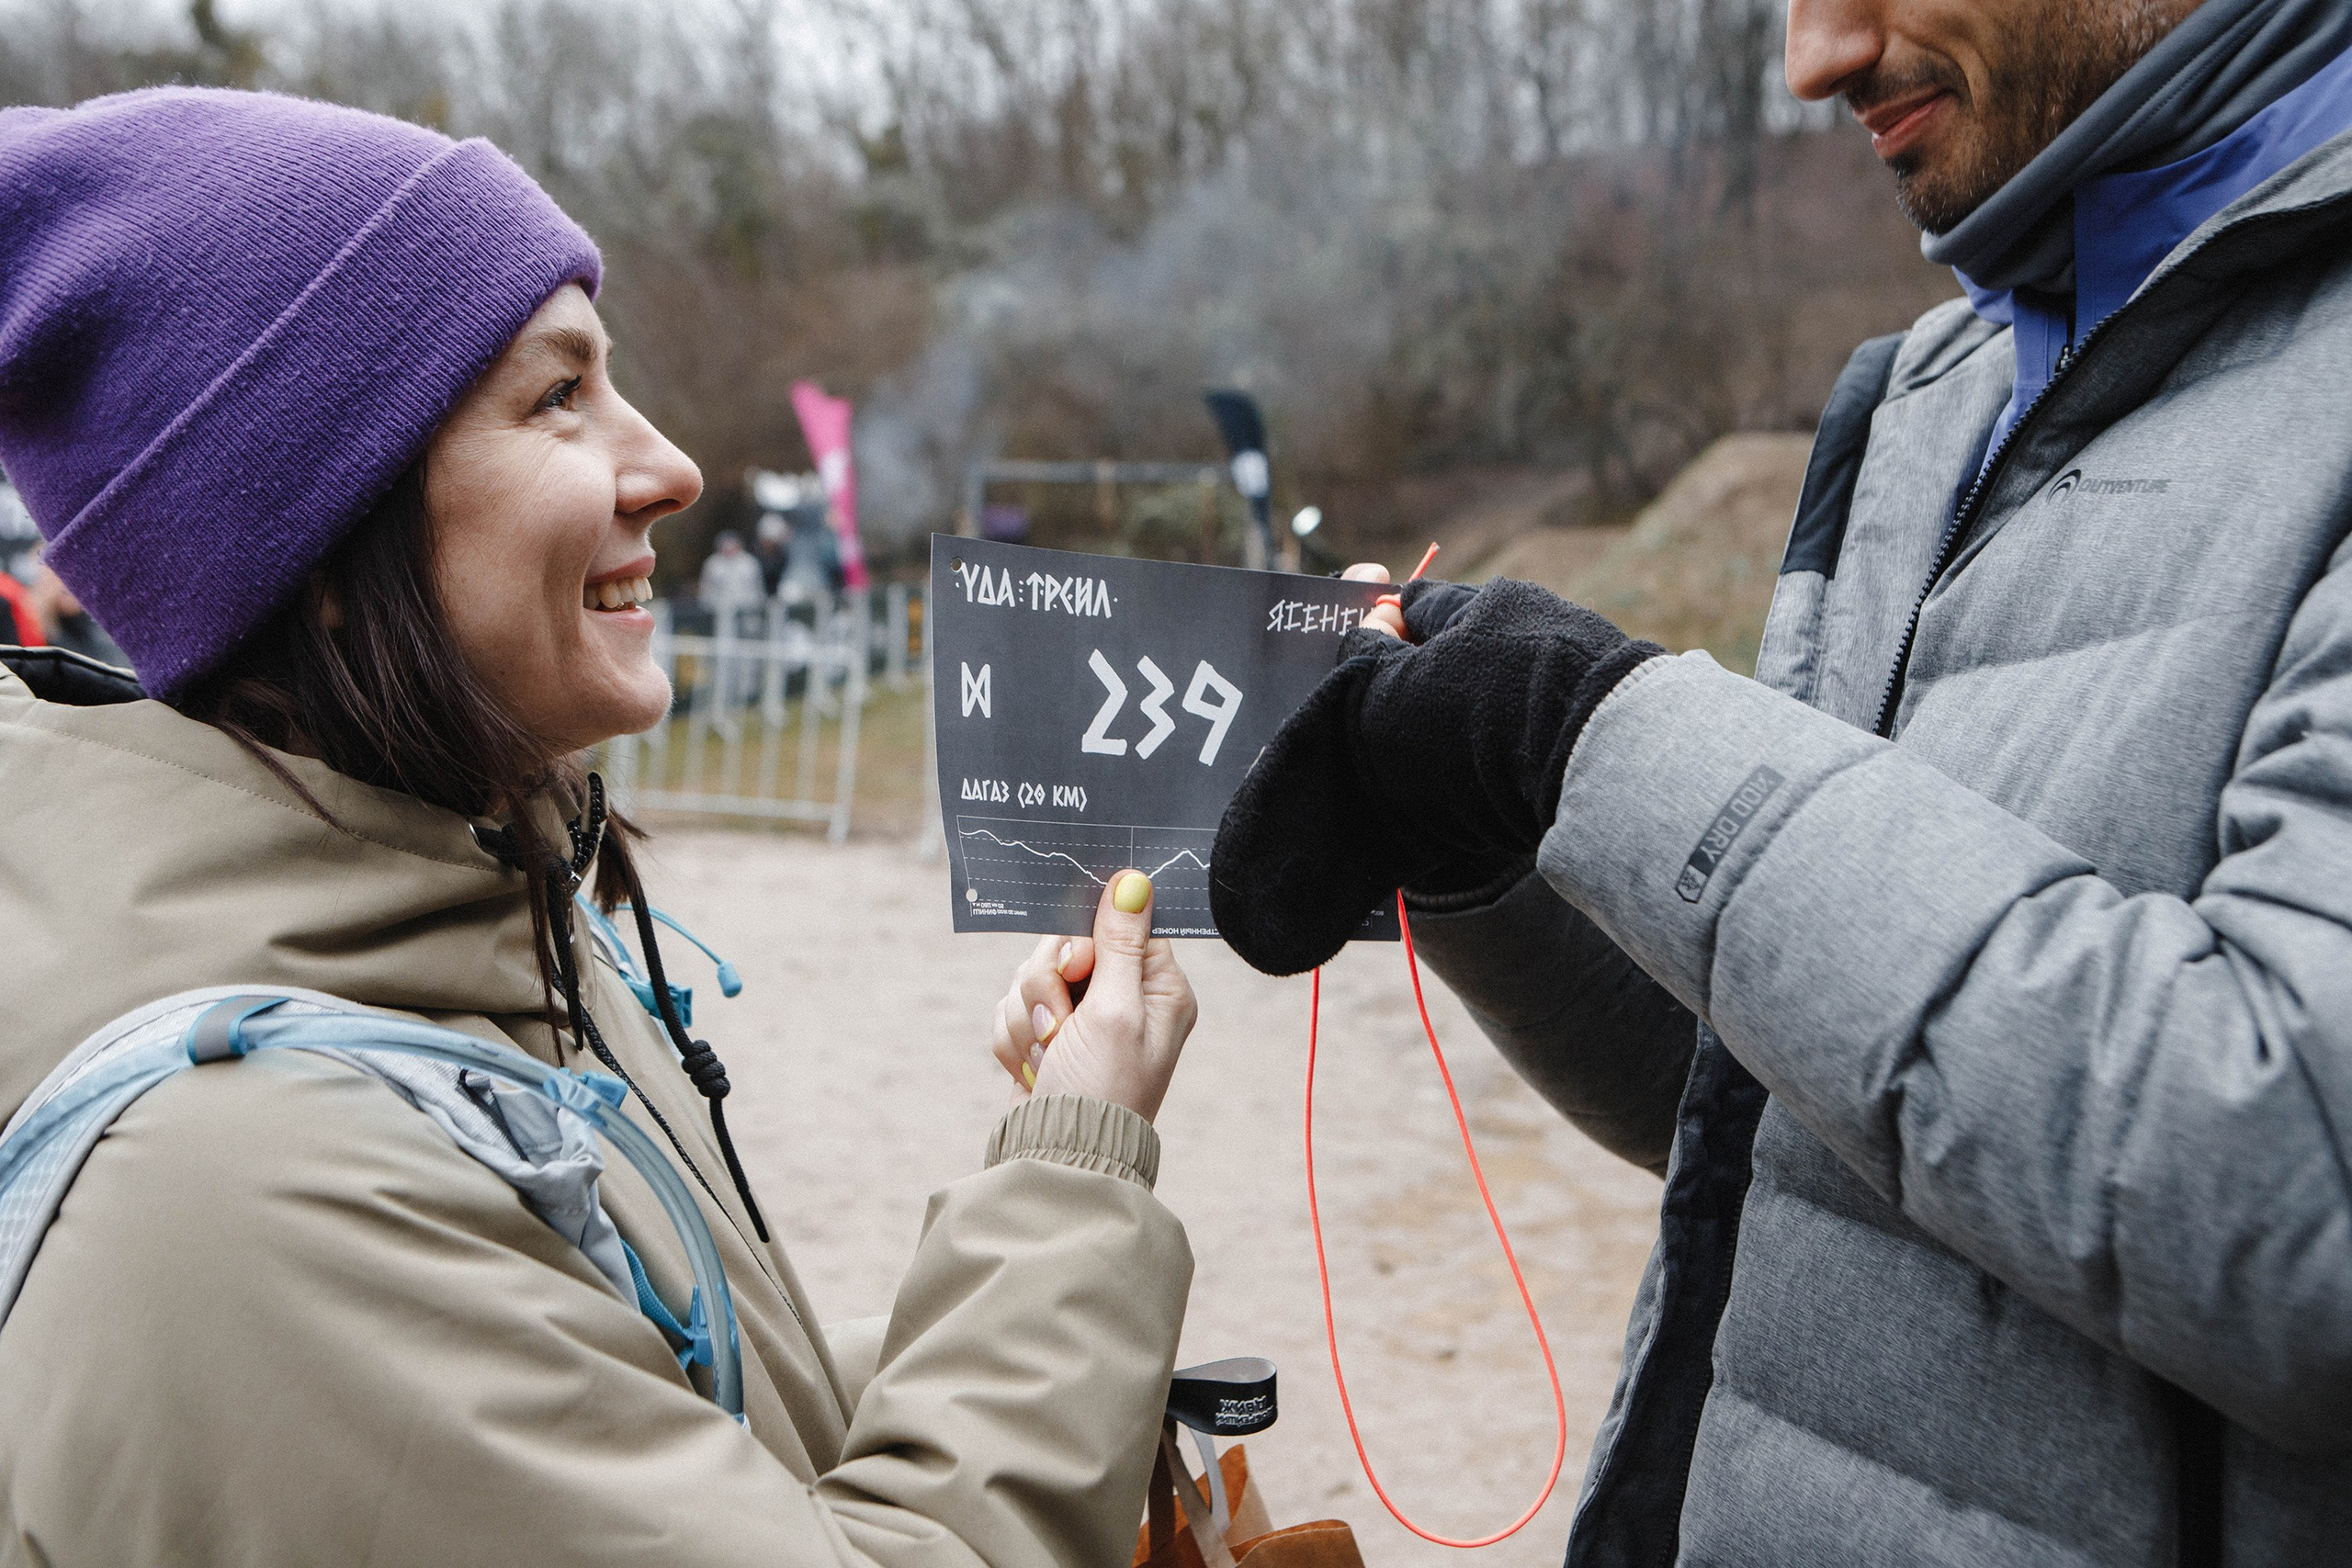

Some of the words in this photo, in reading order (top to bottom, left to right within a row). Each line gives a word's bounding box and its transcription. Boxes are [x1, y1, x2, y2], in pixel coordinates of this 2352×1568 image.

[2078, 478, 2171, 494] OUTVENTURE
[1081, 649, 1243, 766] 239
[961, 777, 1011, 803] ДАГАЗ
[1017, 782, 1046, 808] (20
[1053, 784, 1088, 812] КМ)
[1701, 815, 1741, 863] DRY
[1152, 927, 1179, 935] НОМЕР
